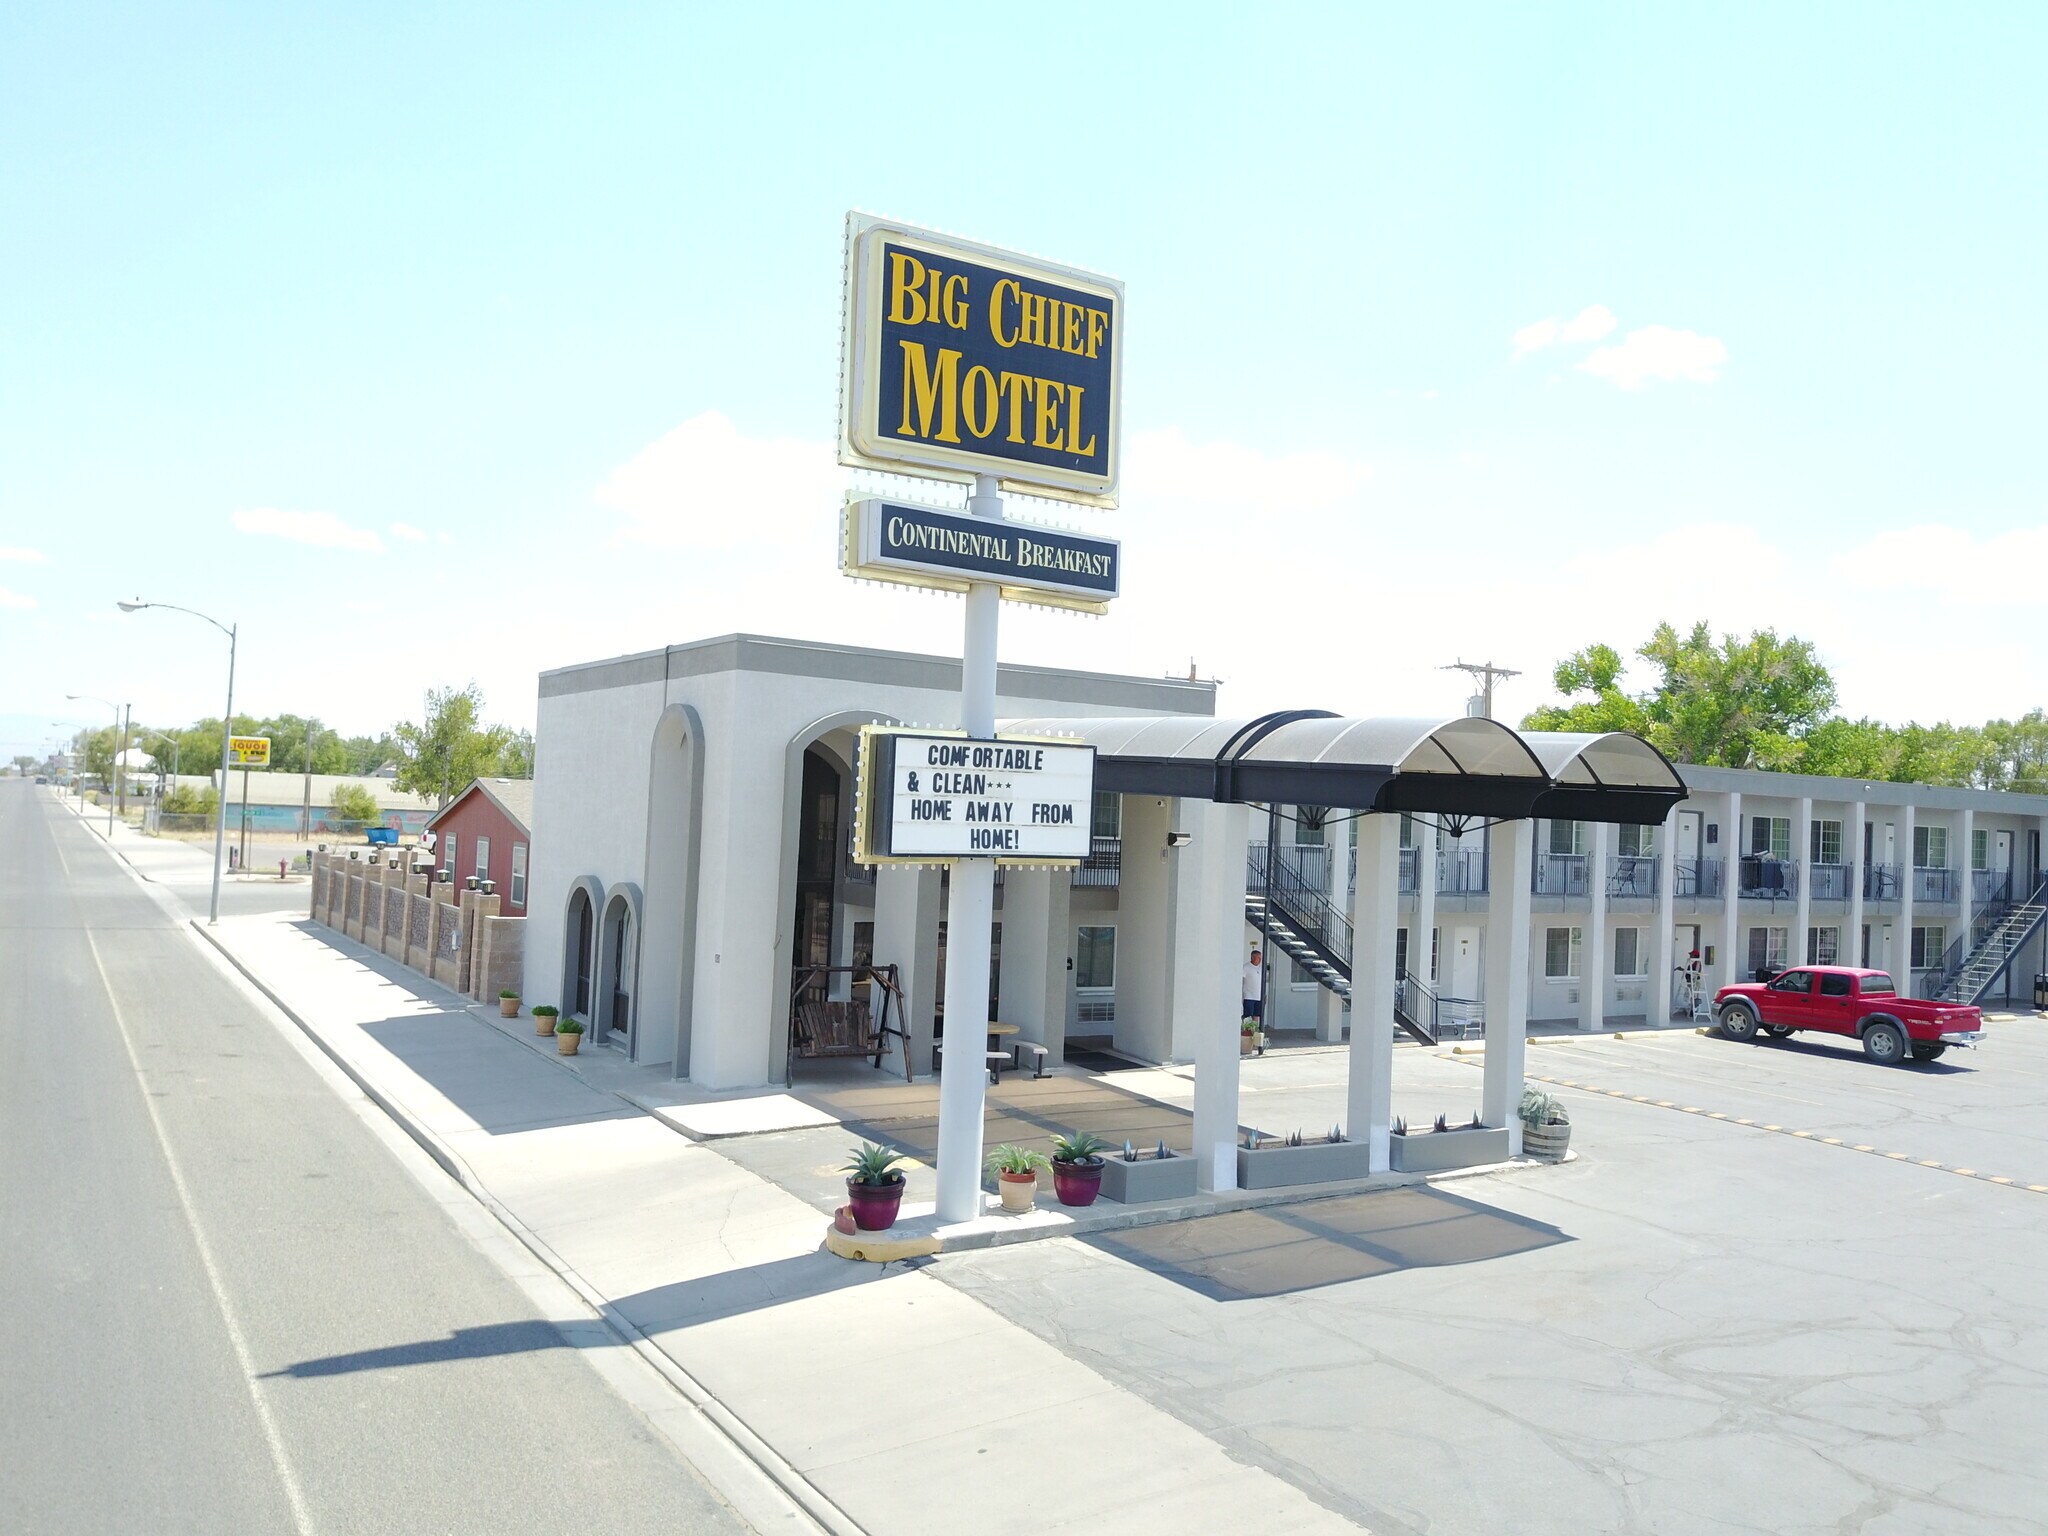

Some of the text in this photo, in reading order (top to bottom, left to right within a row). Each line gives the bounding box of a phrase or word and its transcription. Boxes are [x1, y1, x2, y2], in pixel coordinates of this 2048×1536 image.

[887, 251, 1109, 360] BIG CHIEF
[897, 339, 1096, 457] MOTEL
[887, 516, 1111, 578] CONTINENTAL BREAKFAST
[927, 744, 1044, 771] COMFORTABLE
[907, 770, 920, 793] &
[911, 799, 1073, 824] HOME AWAY FROM
[970, 828, 1020, 850] HOME!
